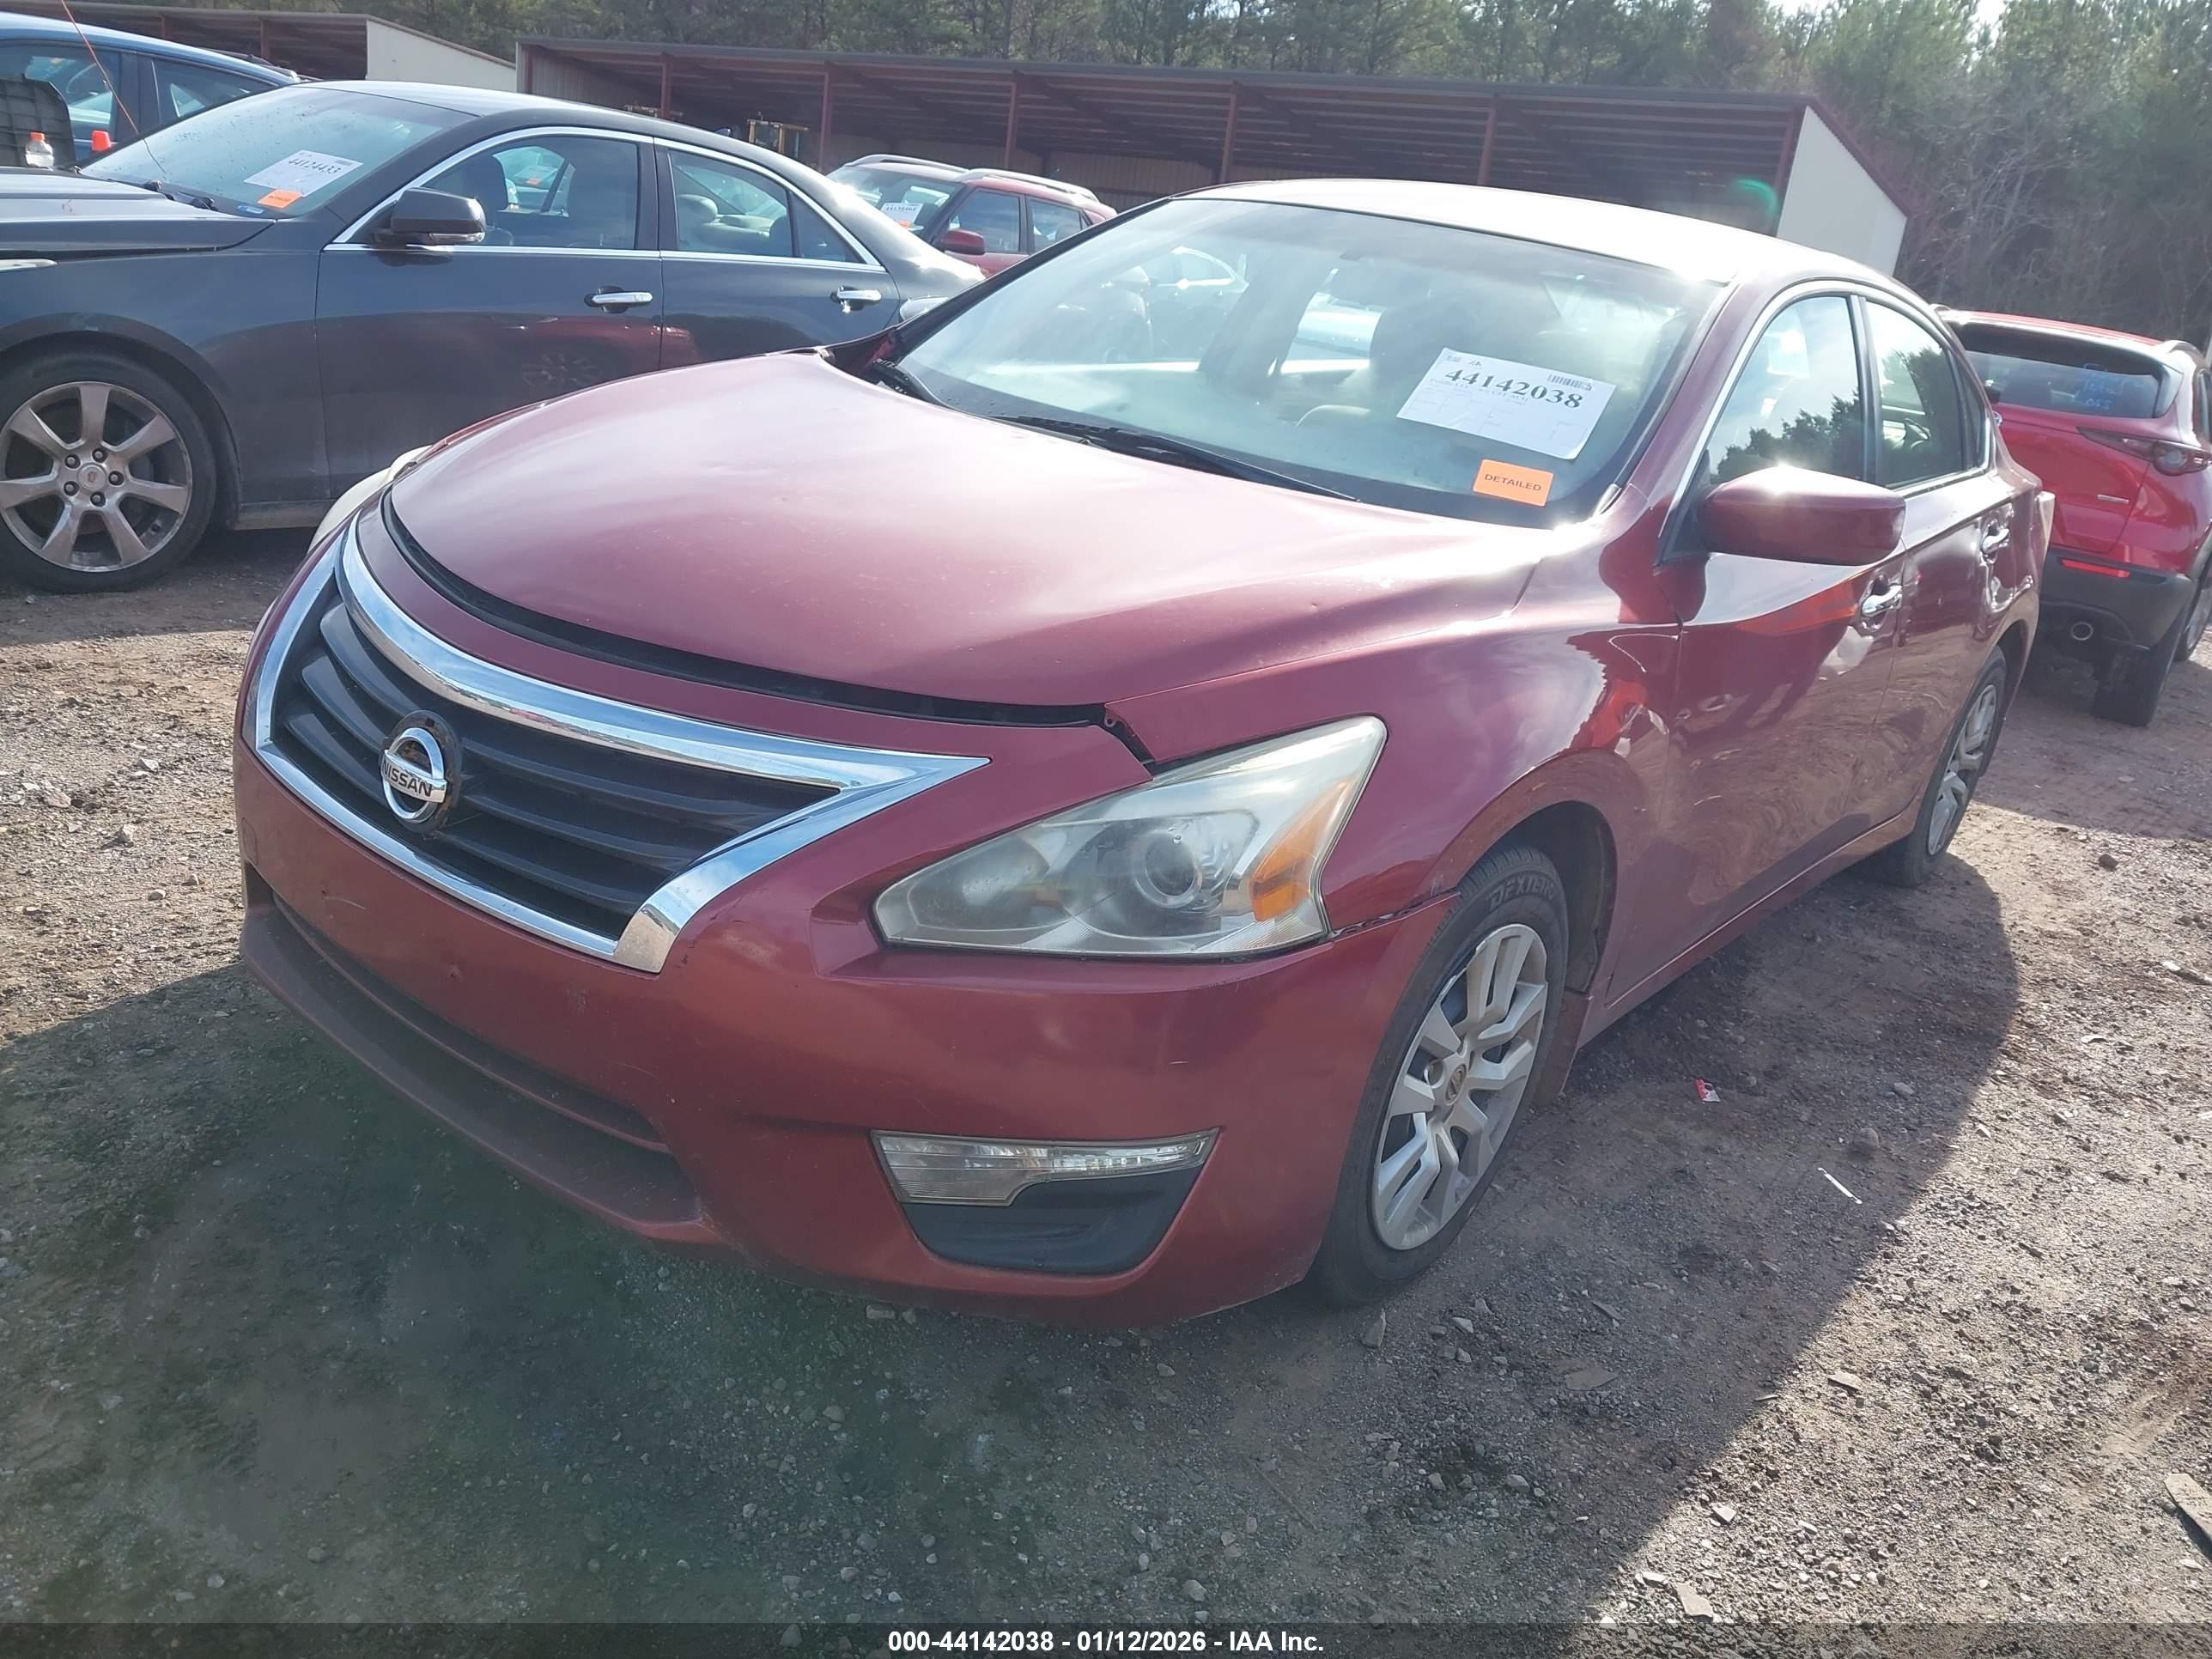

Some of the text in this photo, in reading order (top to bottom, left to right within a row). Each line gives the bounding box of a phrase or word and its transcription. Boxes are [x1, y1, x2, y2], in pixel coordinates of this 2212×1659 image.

[1444, 369, 1583, 409] 44142038
[1484, 473, 1542, 492] DETAILED
[382, 758, 433, 798] NISSAN
